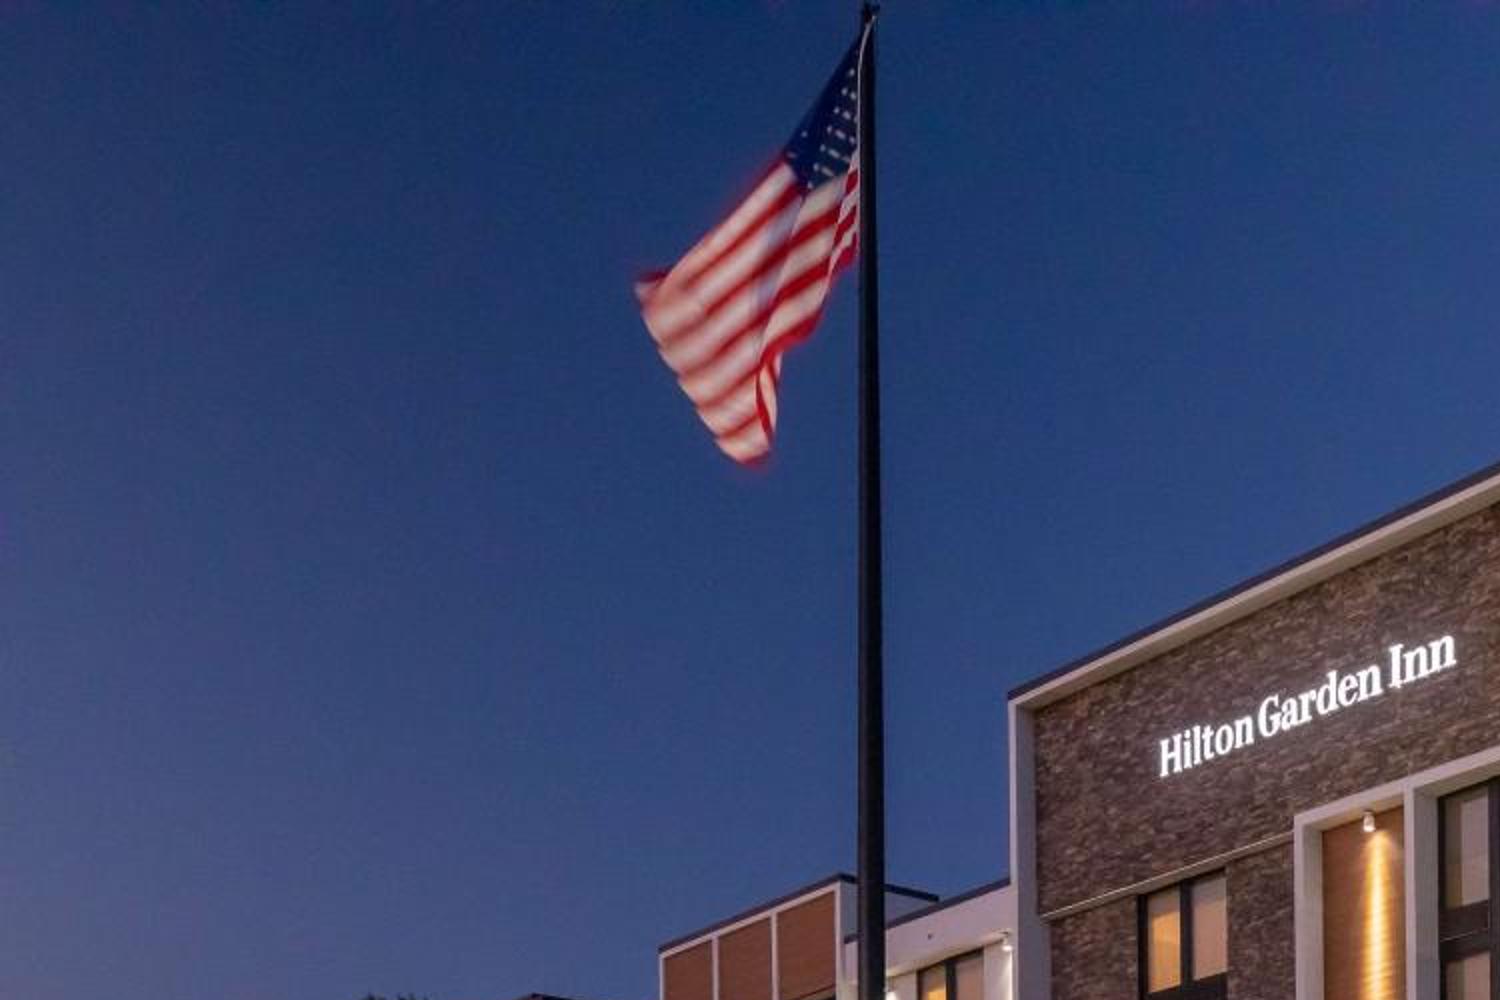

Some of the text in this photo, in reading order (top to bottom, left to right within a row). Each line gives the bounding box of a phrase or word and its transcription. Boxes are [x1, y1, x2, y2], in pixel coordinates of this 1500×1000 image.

[1159, 634, 1457, 778] Hilton Garden Inn
